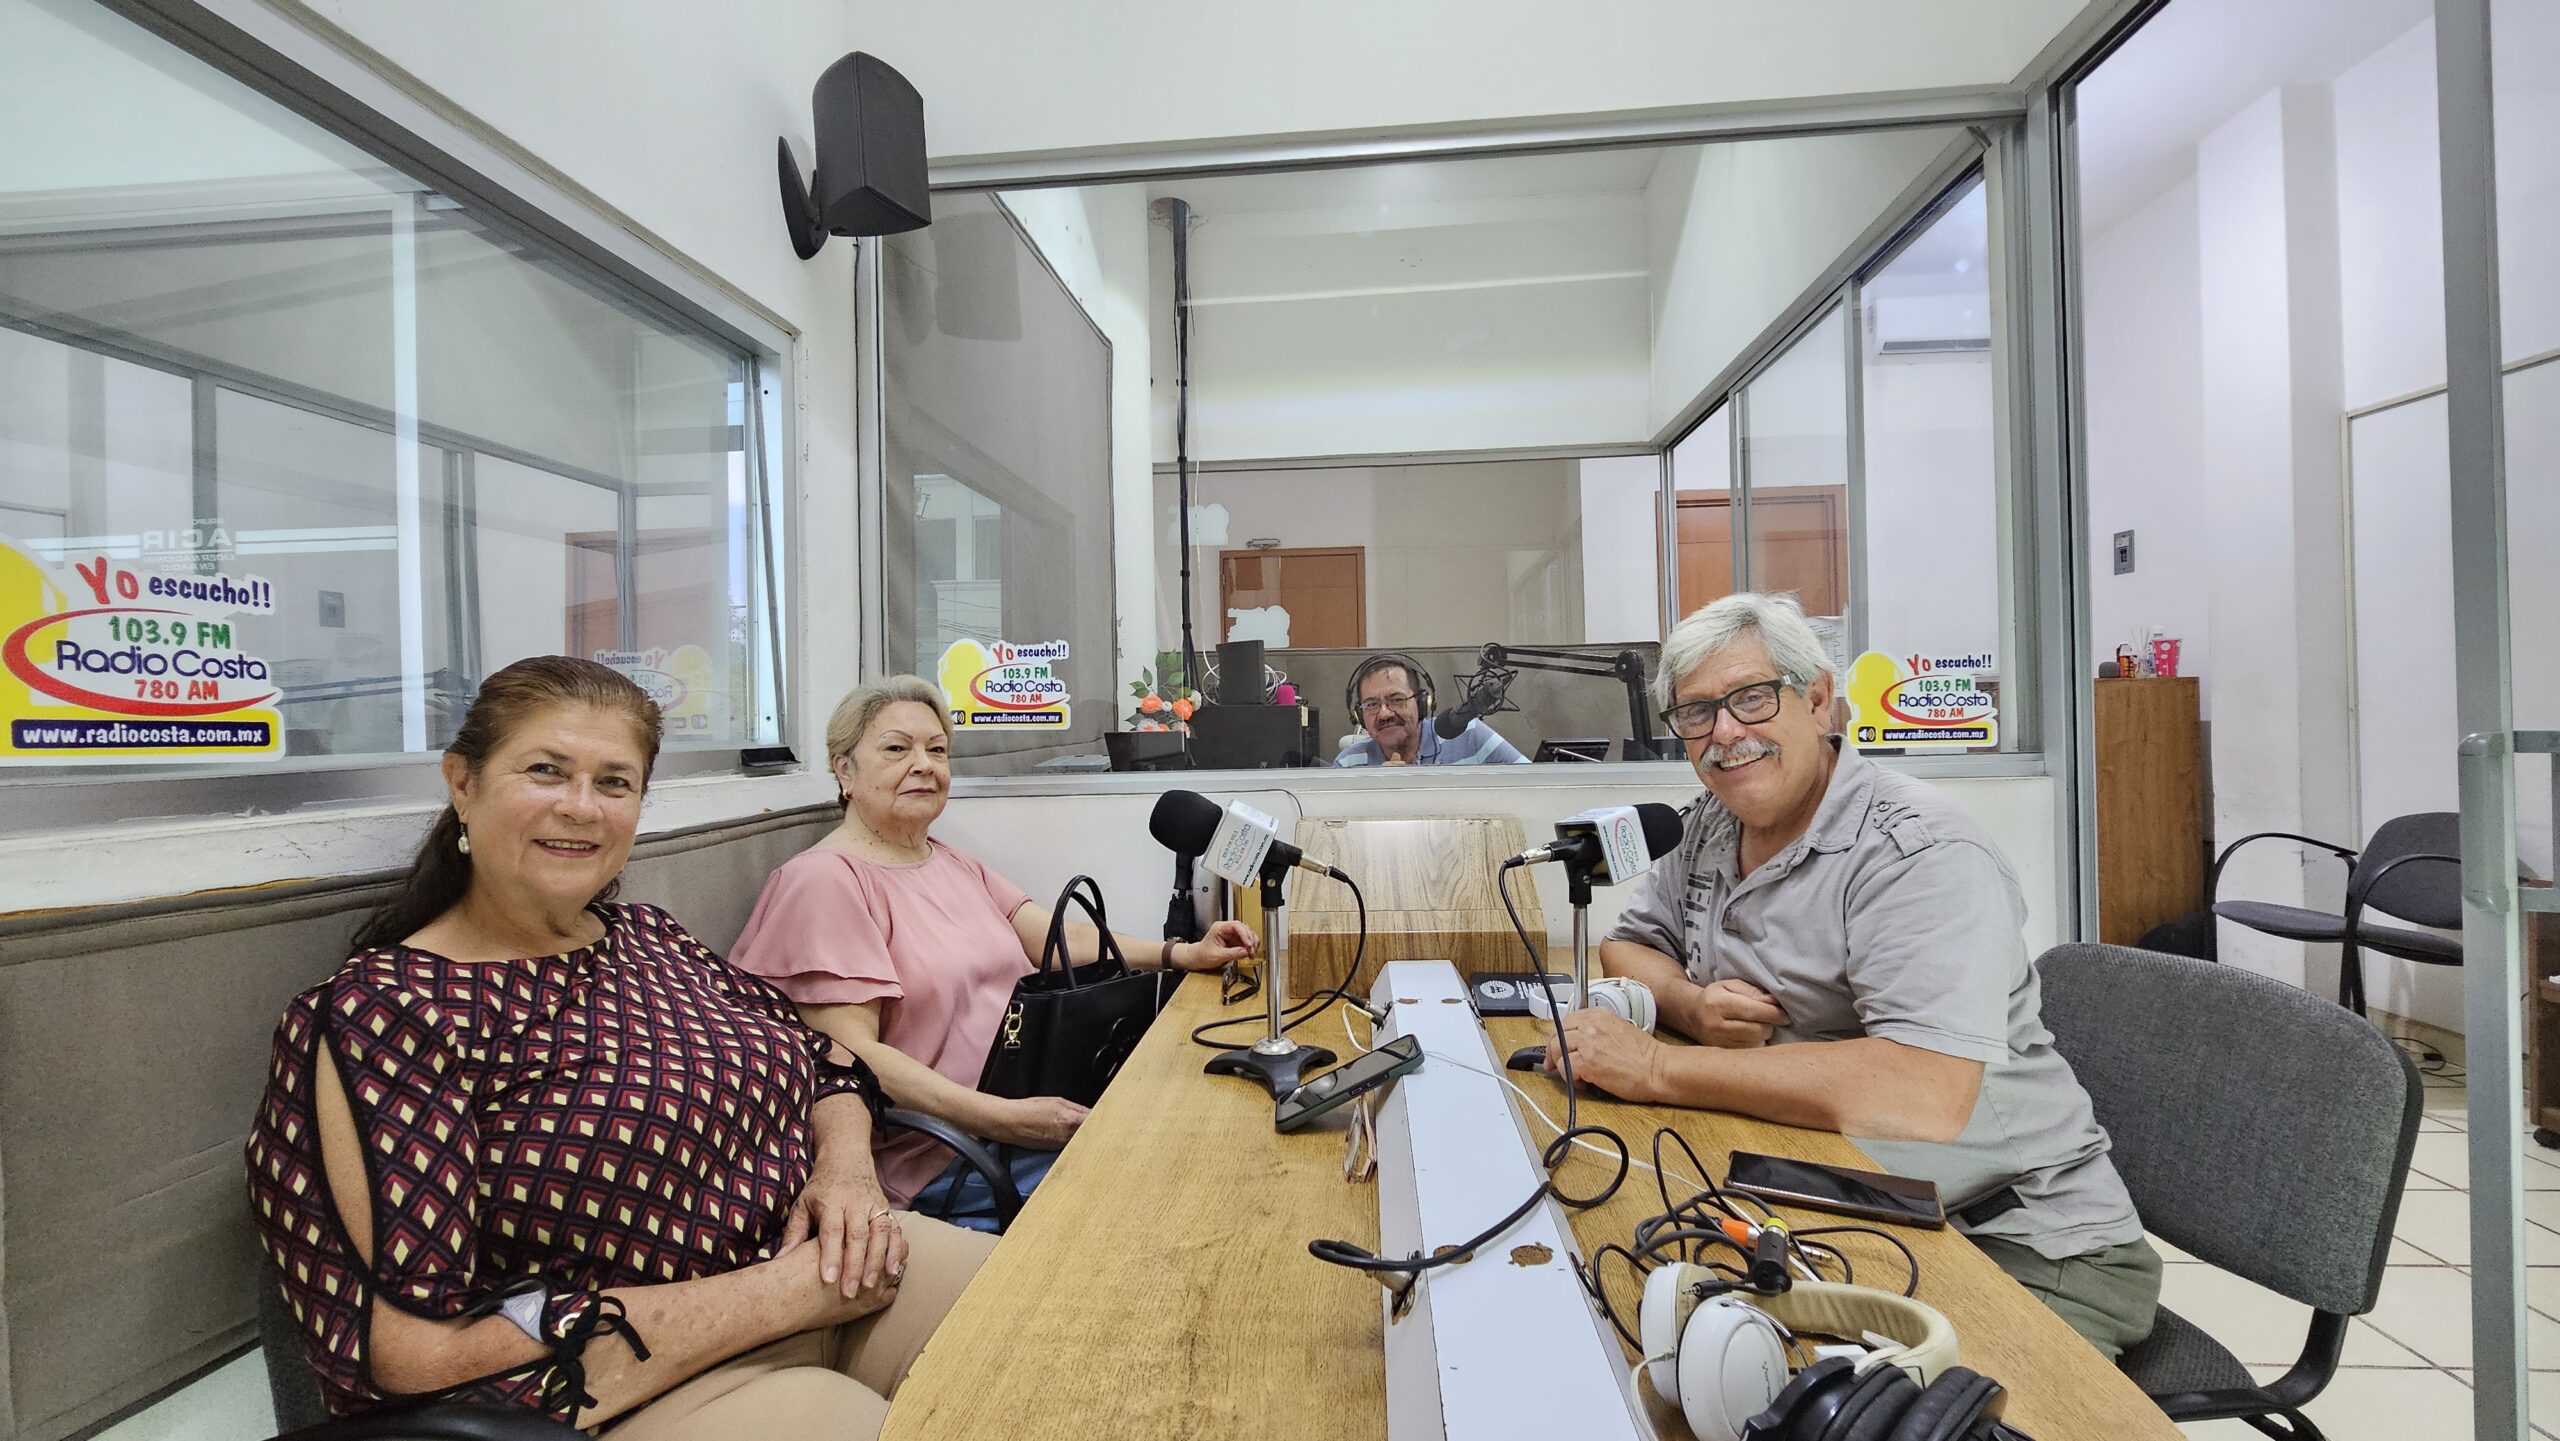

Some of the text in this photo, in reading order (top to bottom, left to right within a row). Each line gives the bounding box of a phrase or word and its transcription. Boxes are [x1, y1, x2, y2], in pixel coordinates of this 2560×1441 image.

[75, 556, 271, 608] Yo escucho!!
[109, 615, 231, 649] 103.9 FM
[56, 640, 267, 680] Radio Costa
[993, 644, 1066, 664] Yo escucho!!
[1907, 654, 1992, 675] Yo escucho!!
[1003, 667, 1048, 679] 103.9 FM
[134, 679, 219, 700] 780 AM
[986, 680, 1062, 693] Radio Costa
[1919, 679, 1971, 692] 103.9 FM
[1011, 694, 1042, 703] 780 AM
[1898, 694, 1988, 707] Radio Costa
[974, 713, 1060, 723] www.radiocosta.com.mx
[1927, 708, 1964, 718] 780 AM
[23, 723, 263, 744] www.radiocosta.com.mx
[1885, 730, 1984, 740] www.radiocosta.com.mx
